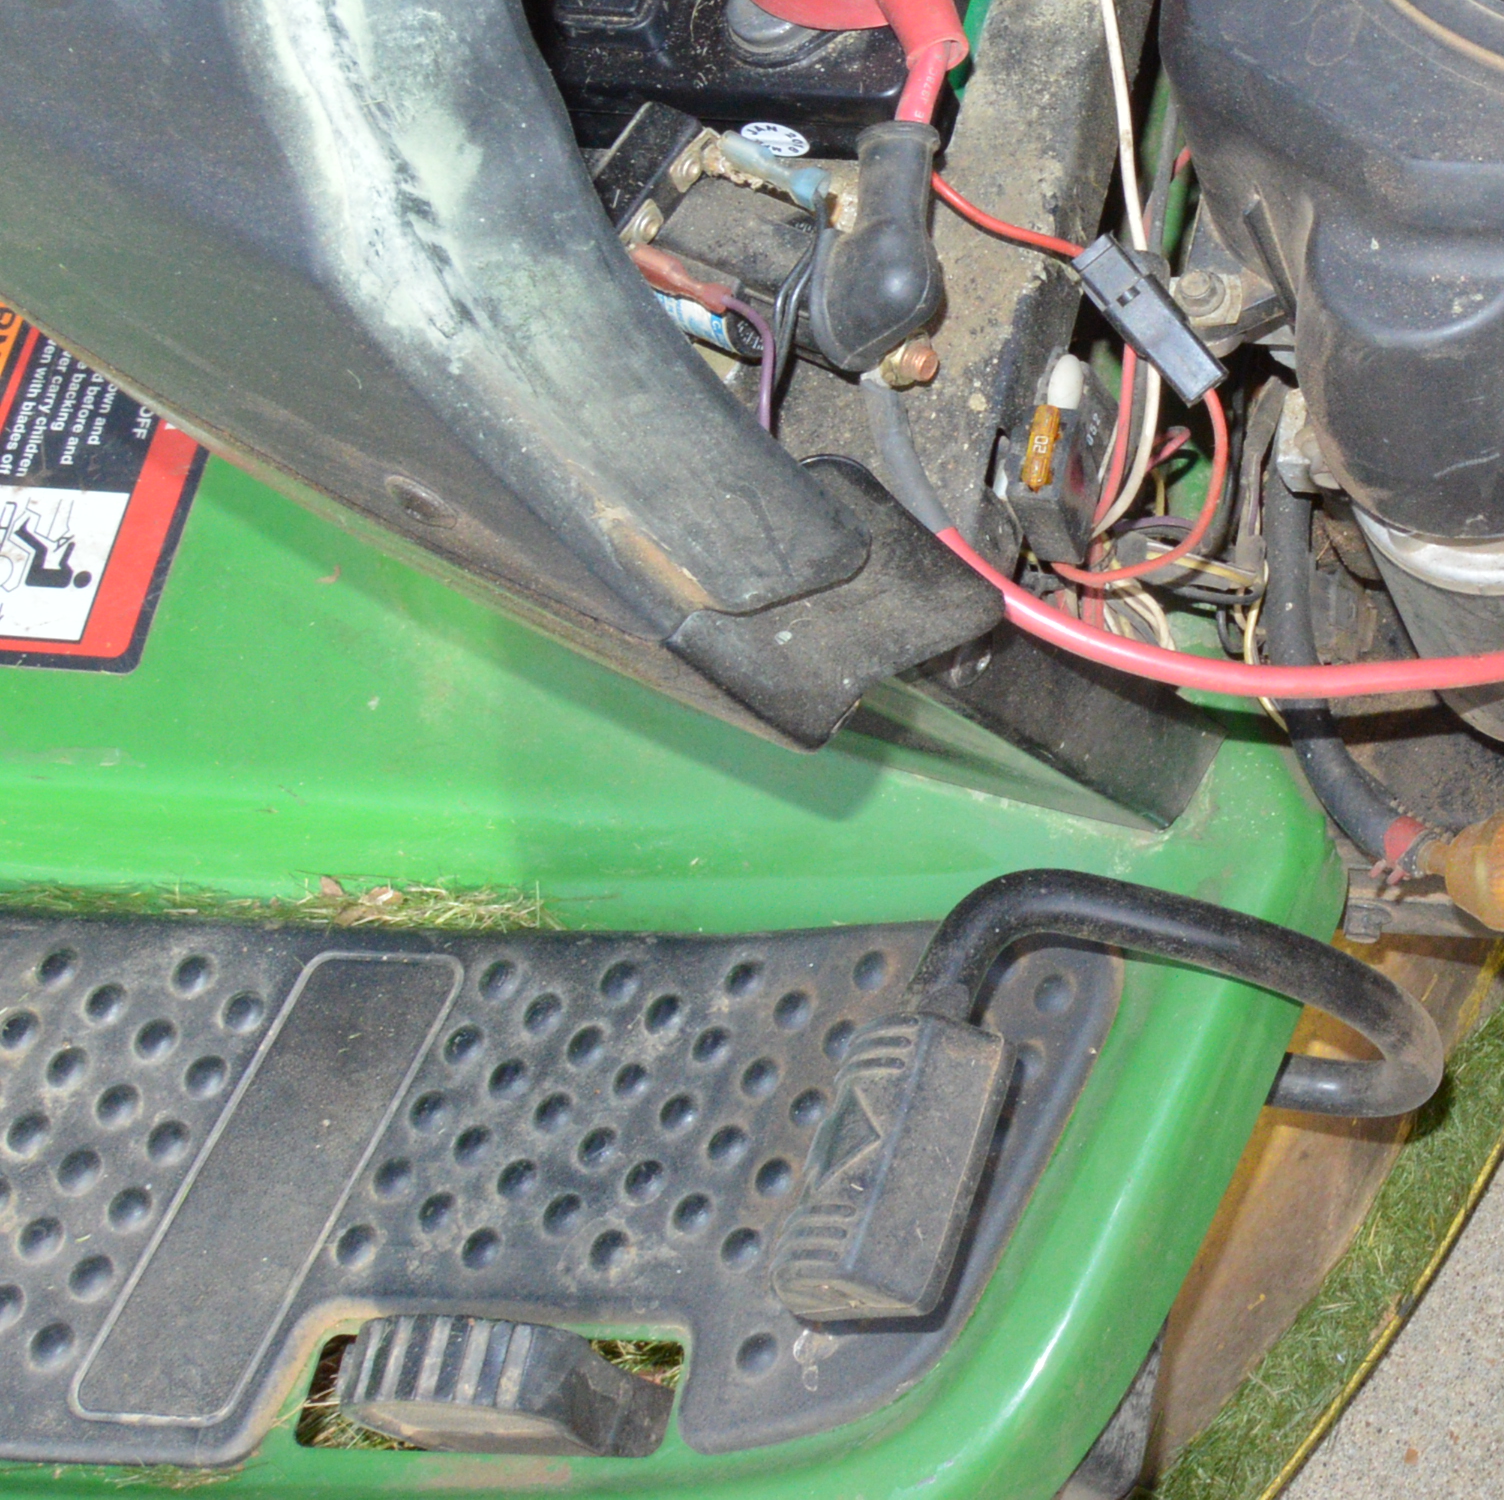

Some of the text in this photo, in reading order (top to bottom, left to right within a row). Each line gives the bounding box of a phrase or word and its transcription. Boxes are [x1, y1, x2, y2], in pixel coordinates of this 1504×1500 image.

[746, 125, 778, 136] JAN
[39, 339, 57, 364] ven
[26, 367, 48, 398] with
[37, 375, 63, 414] carry
[50, 373, 87, 432] backing
[72, 385, 102, 434] before
[86, 383, 119, 446] own and
[6, 401, 36, 451] blades
[1033, 435, 1049, 453] 20
[15, 416, 48, 478] children
[59, 436, 79, 465] and
